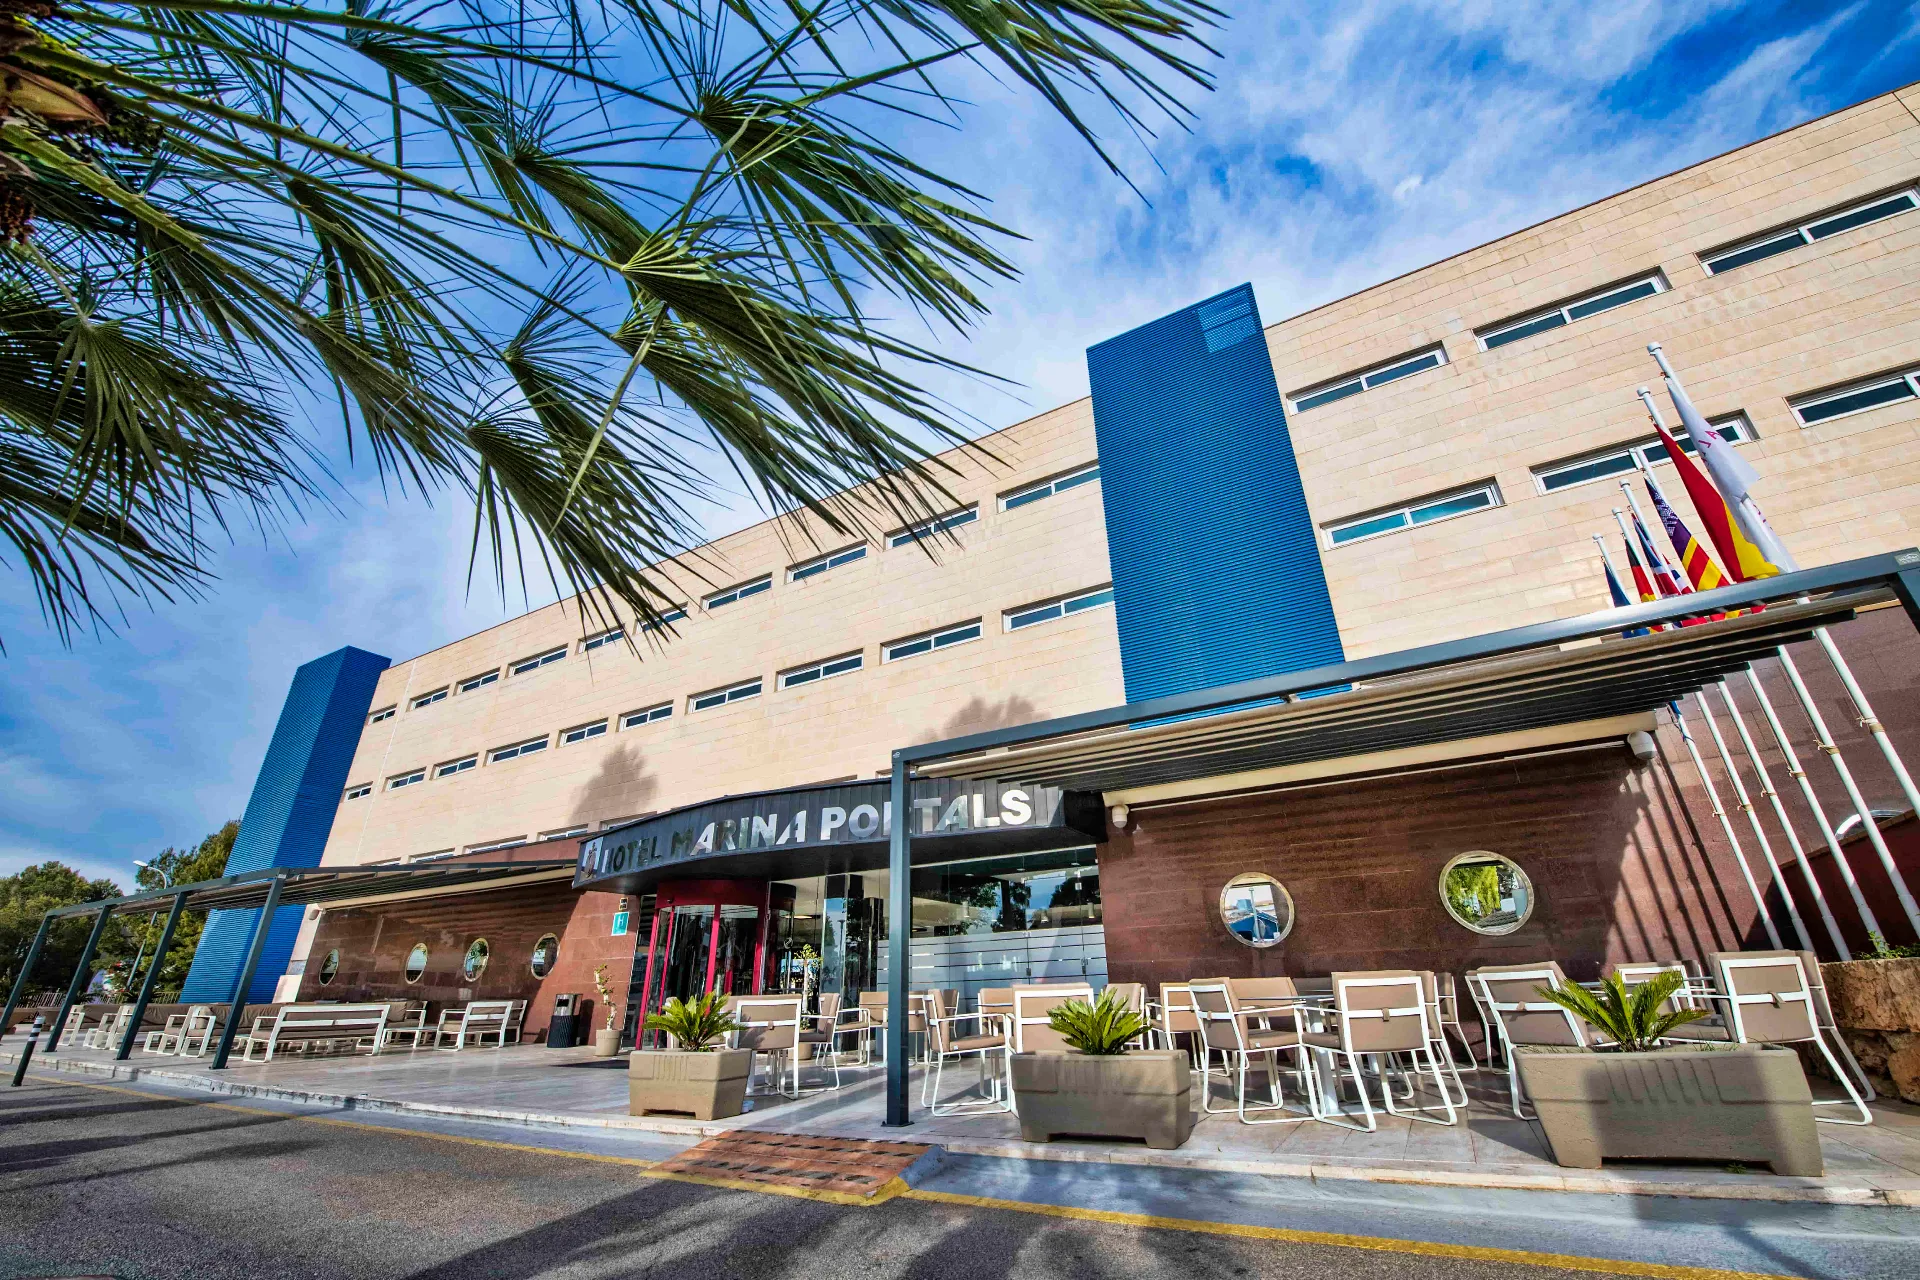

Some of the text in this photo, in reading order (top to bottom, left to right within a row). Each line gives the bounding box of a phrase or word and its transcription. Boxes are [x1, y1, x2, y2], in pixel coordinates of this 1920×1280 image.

[601, 836, 663, 873] HOTEL
[671, 810, 807, 857] MARINA
[617, 915, 625, 928] H
